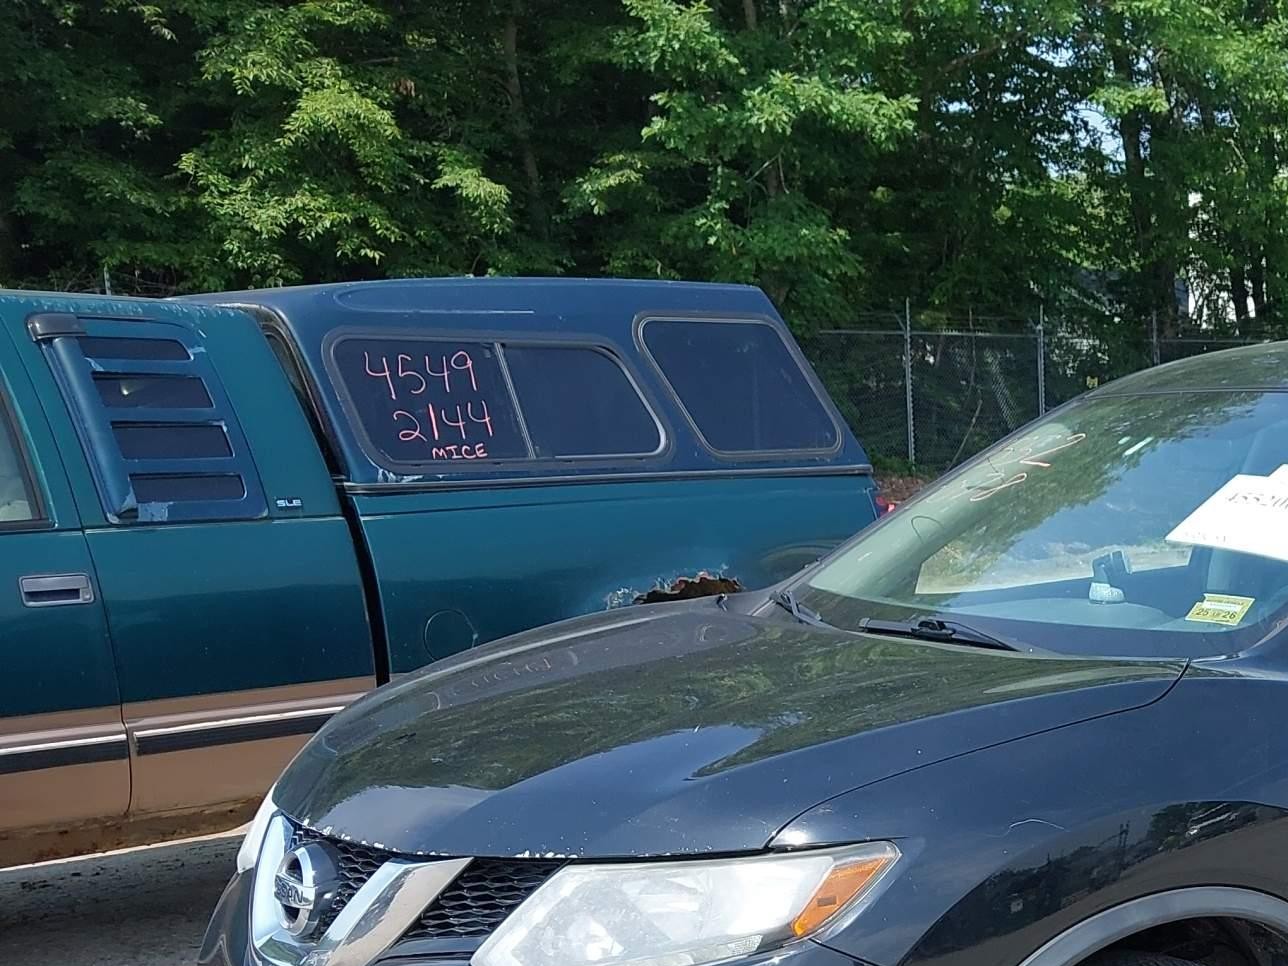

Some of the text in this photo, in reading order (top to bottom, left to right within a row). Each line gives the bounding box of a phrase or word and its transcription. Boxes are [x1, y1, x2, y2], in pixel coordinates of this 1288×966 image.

[363, 350, 478, 401] 4549
[393, 400, 494, 442] 2144
[431, 442, 489, 461] MICE
[276, 499, 302, 507] SLE
[1195, 608, 1210, 617] 25
[1221, 610, 1238, 620] 26
